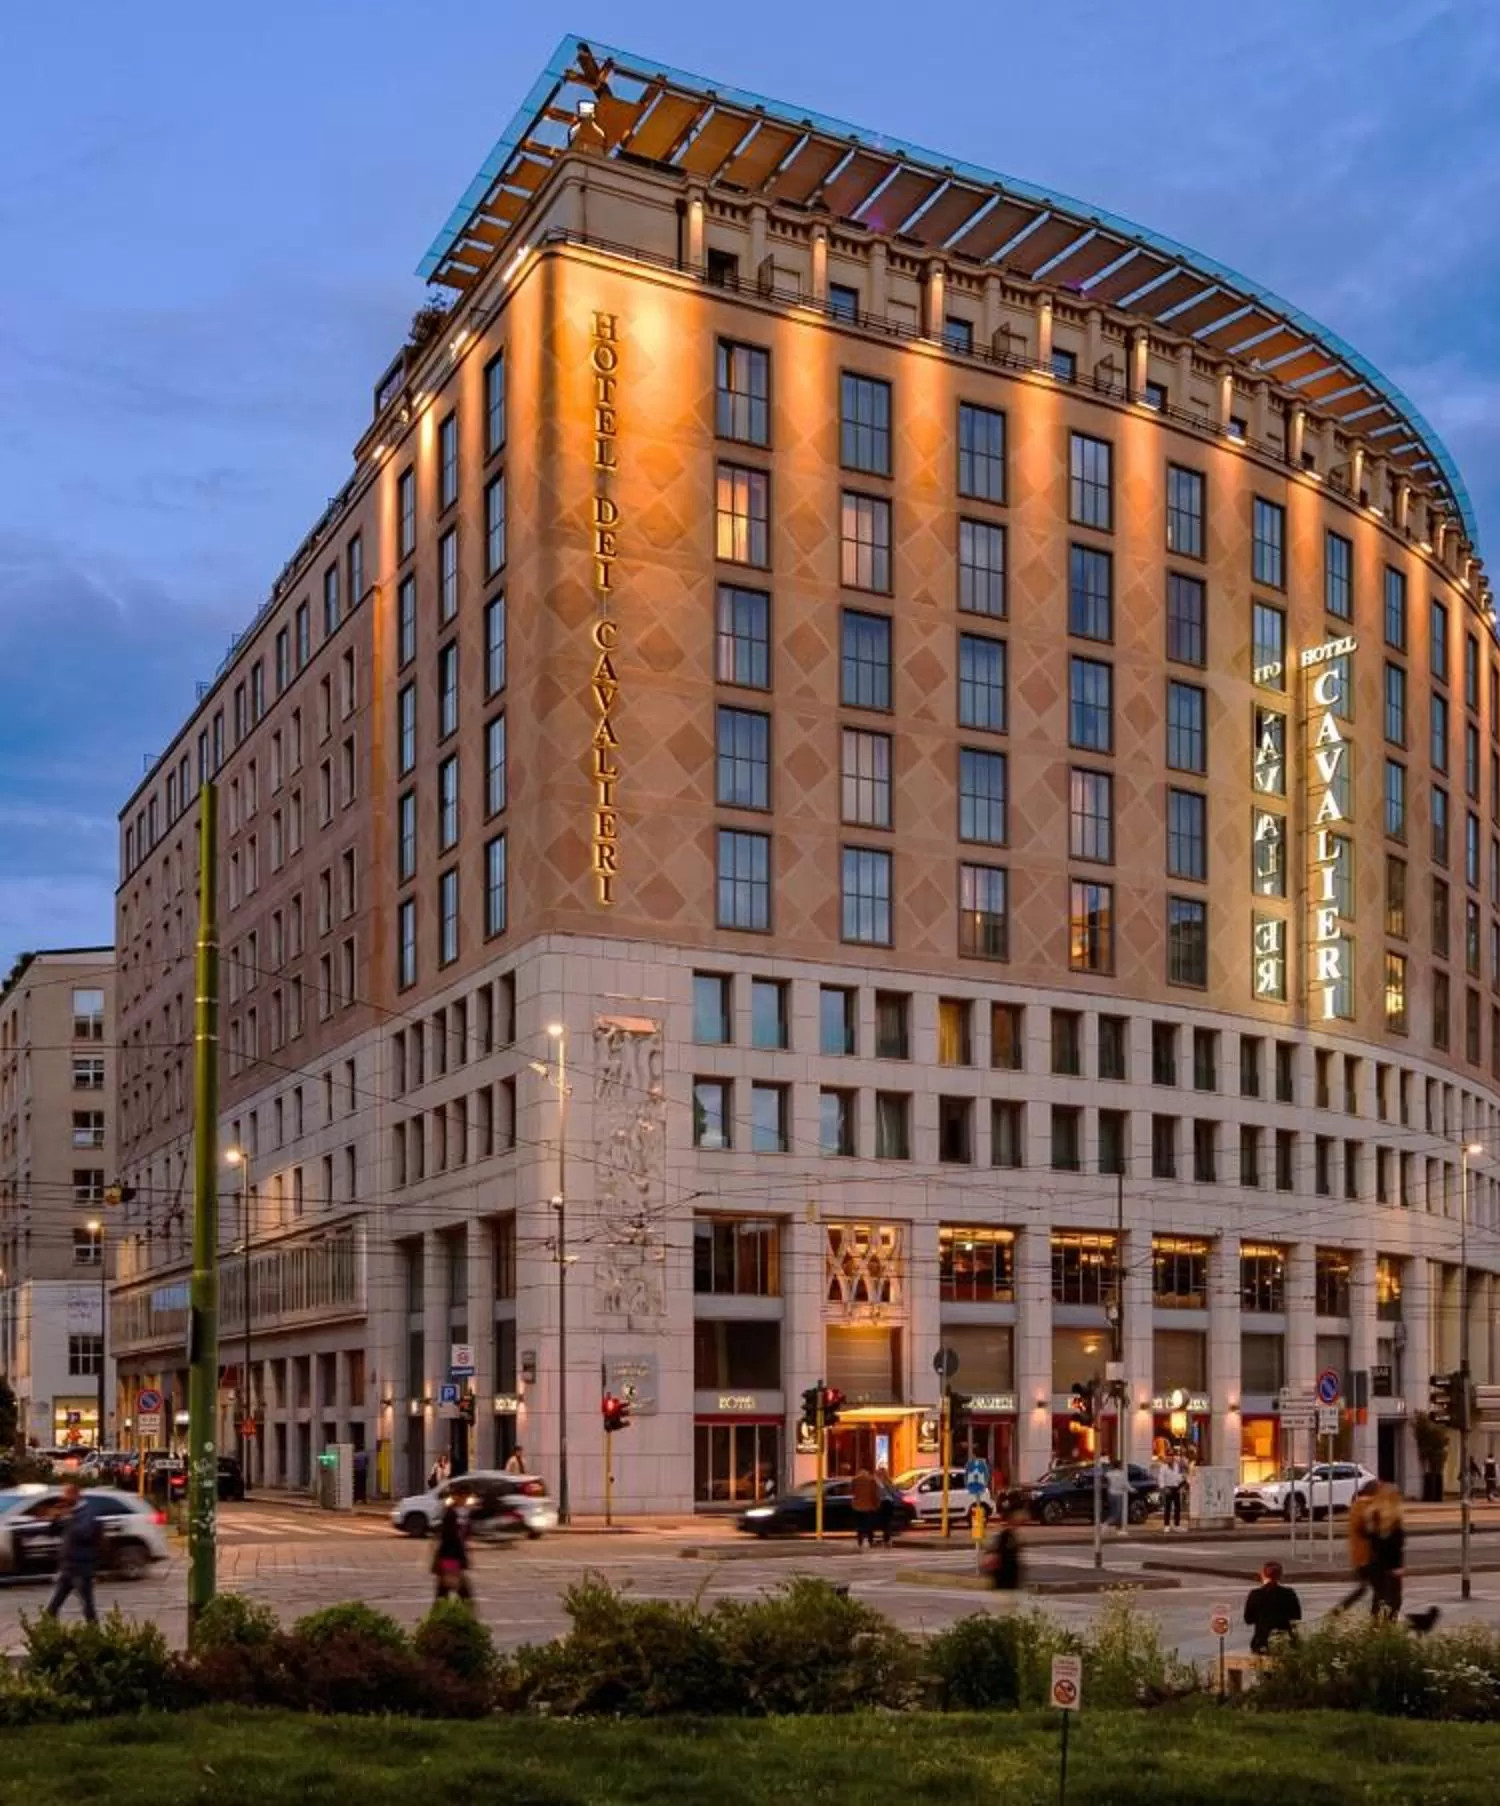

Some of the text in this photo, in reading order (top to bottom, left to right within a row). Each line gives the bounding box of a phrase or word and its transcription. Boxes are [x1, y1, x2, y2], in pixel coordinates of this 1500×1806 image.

[592, 311, 618, 905] HOTEL DEI CAVALIERI
[1301, 636, 1358, 667] HOTEL
[1313, 669, 1344, 1020] CAVALIERI
